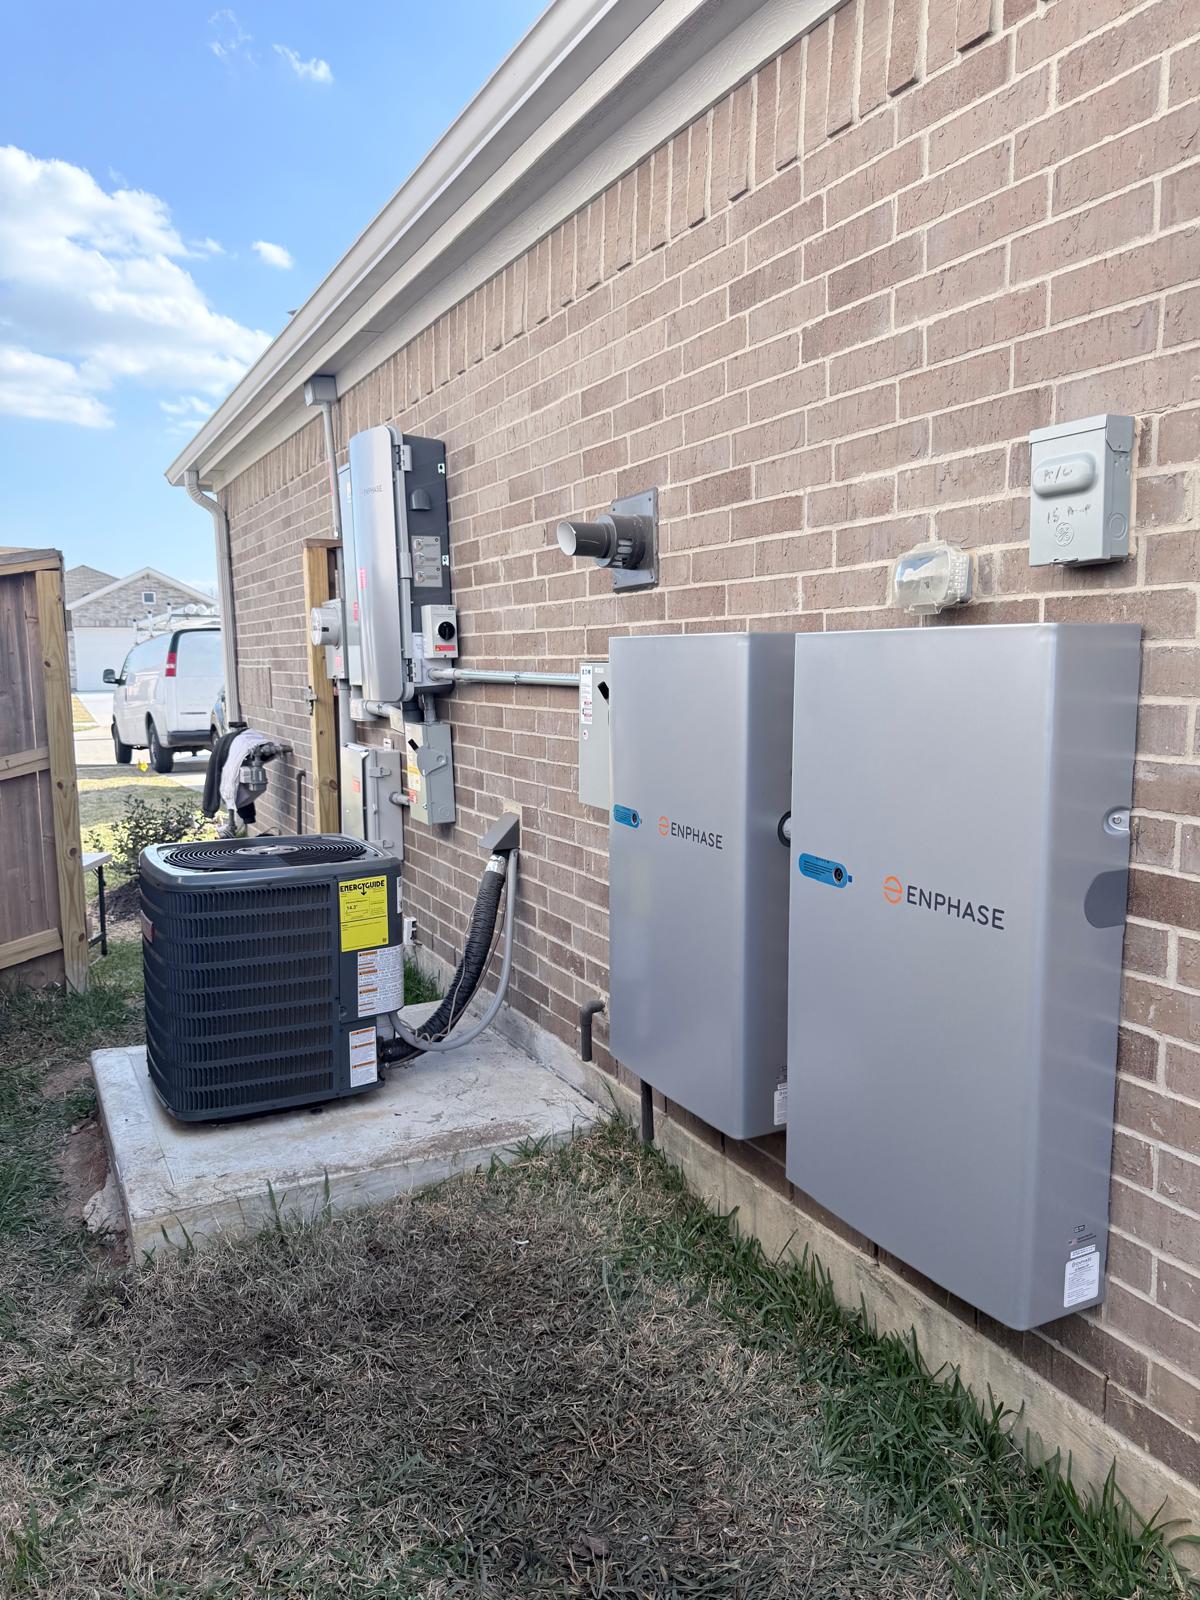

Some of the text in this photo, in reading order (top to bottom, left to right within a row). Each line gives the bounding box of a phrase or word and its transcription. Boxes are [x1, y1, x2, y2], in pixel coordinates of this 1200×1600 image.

[671, 821, 723, 850] ENPHASE
[340, 879, 385, 893] ENERGYGUIDE
[906, 885, 1005, 930] ENPHASE
